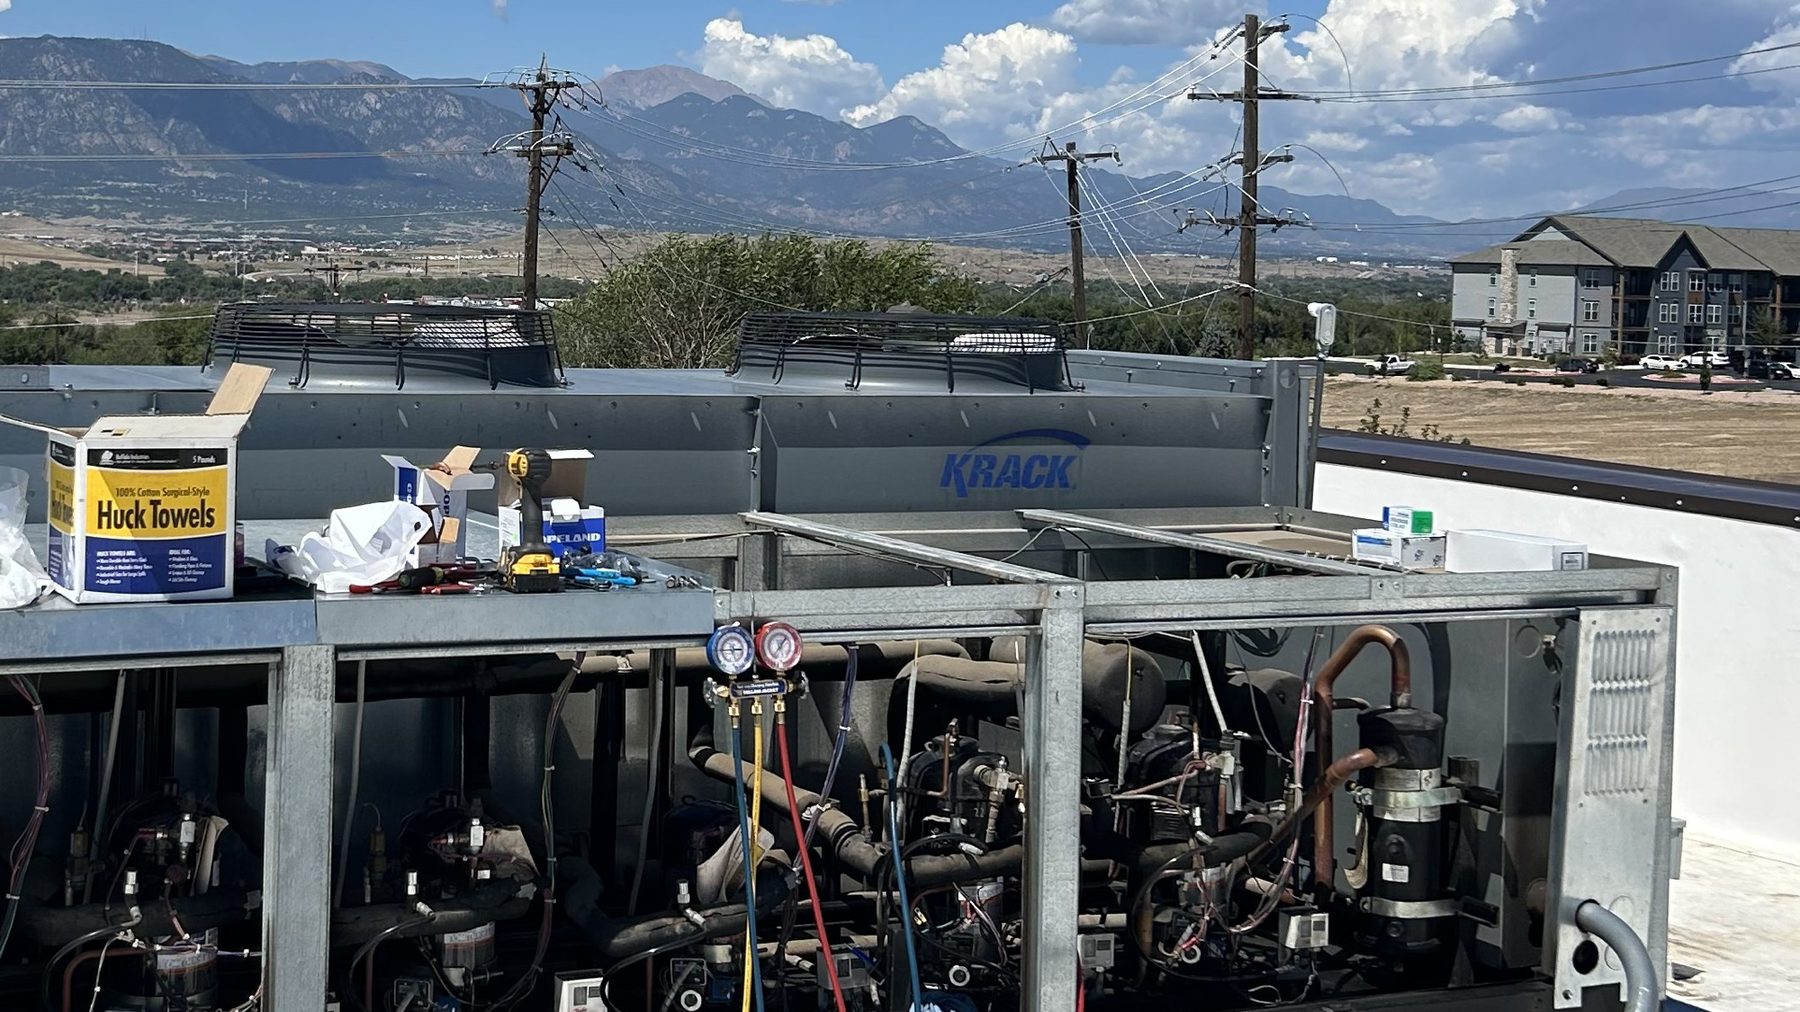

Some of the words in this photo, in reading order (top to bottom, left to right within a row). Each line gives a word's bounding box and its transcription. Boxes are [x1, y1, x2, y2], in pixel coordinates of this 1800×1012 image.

[192, 455, 197, 464] 5
[197, 455, 216, 464] Pounds
[939, 454, 1077, 498] KRACK
[116, 488, 136, 497] 100%
[137, 487, 161, 497] Cotton
[162, 486, 210, 498] Surgical-Style
[97, 500, 146, 529] Huck
[150, 499, 215, 528] Towels
[543, 532, 601, 544] PELAND
